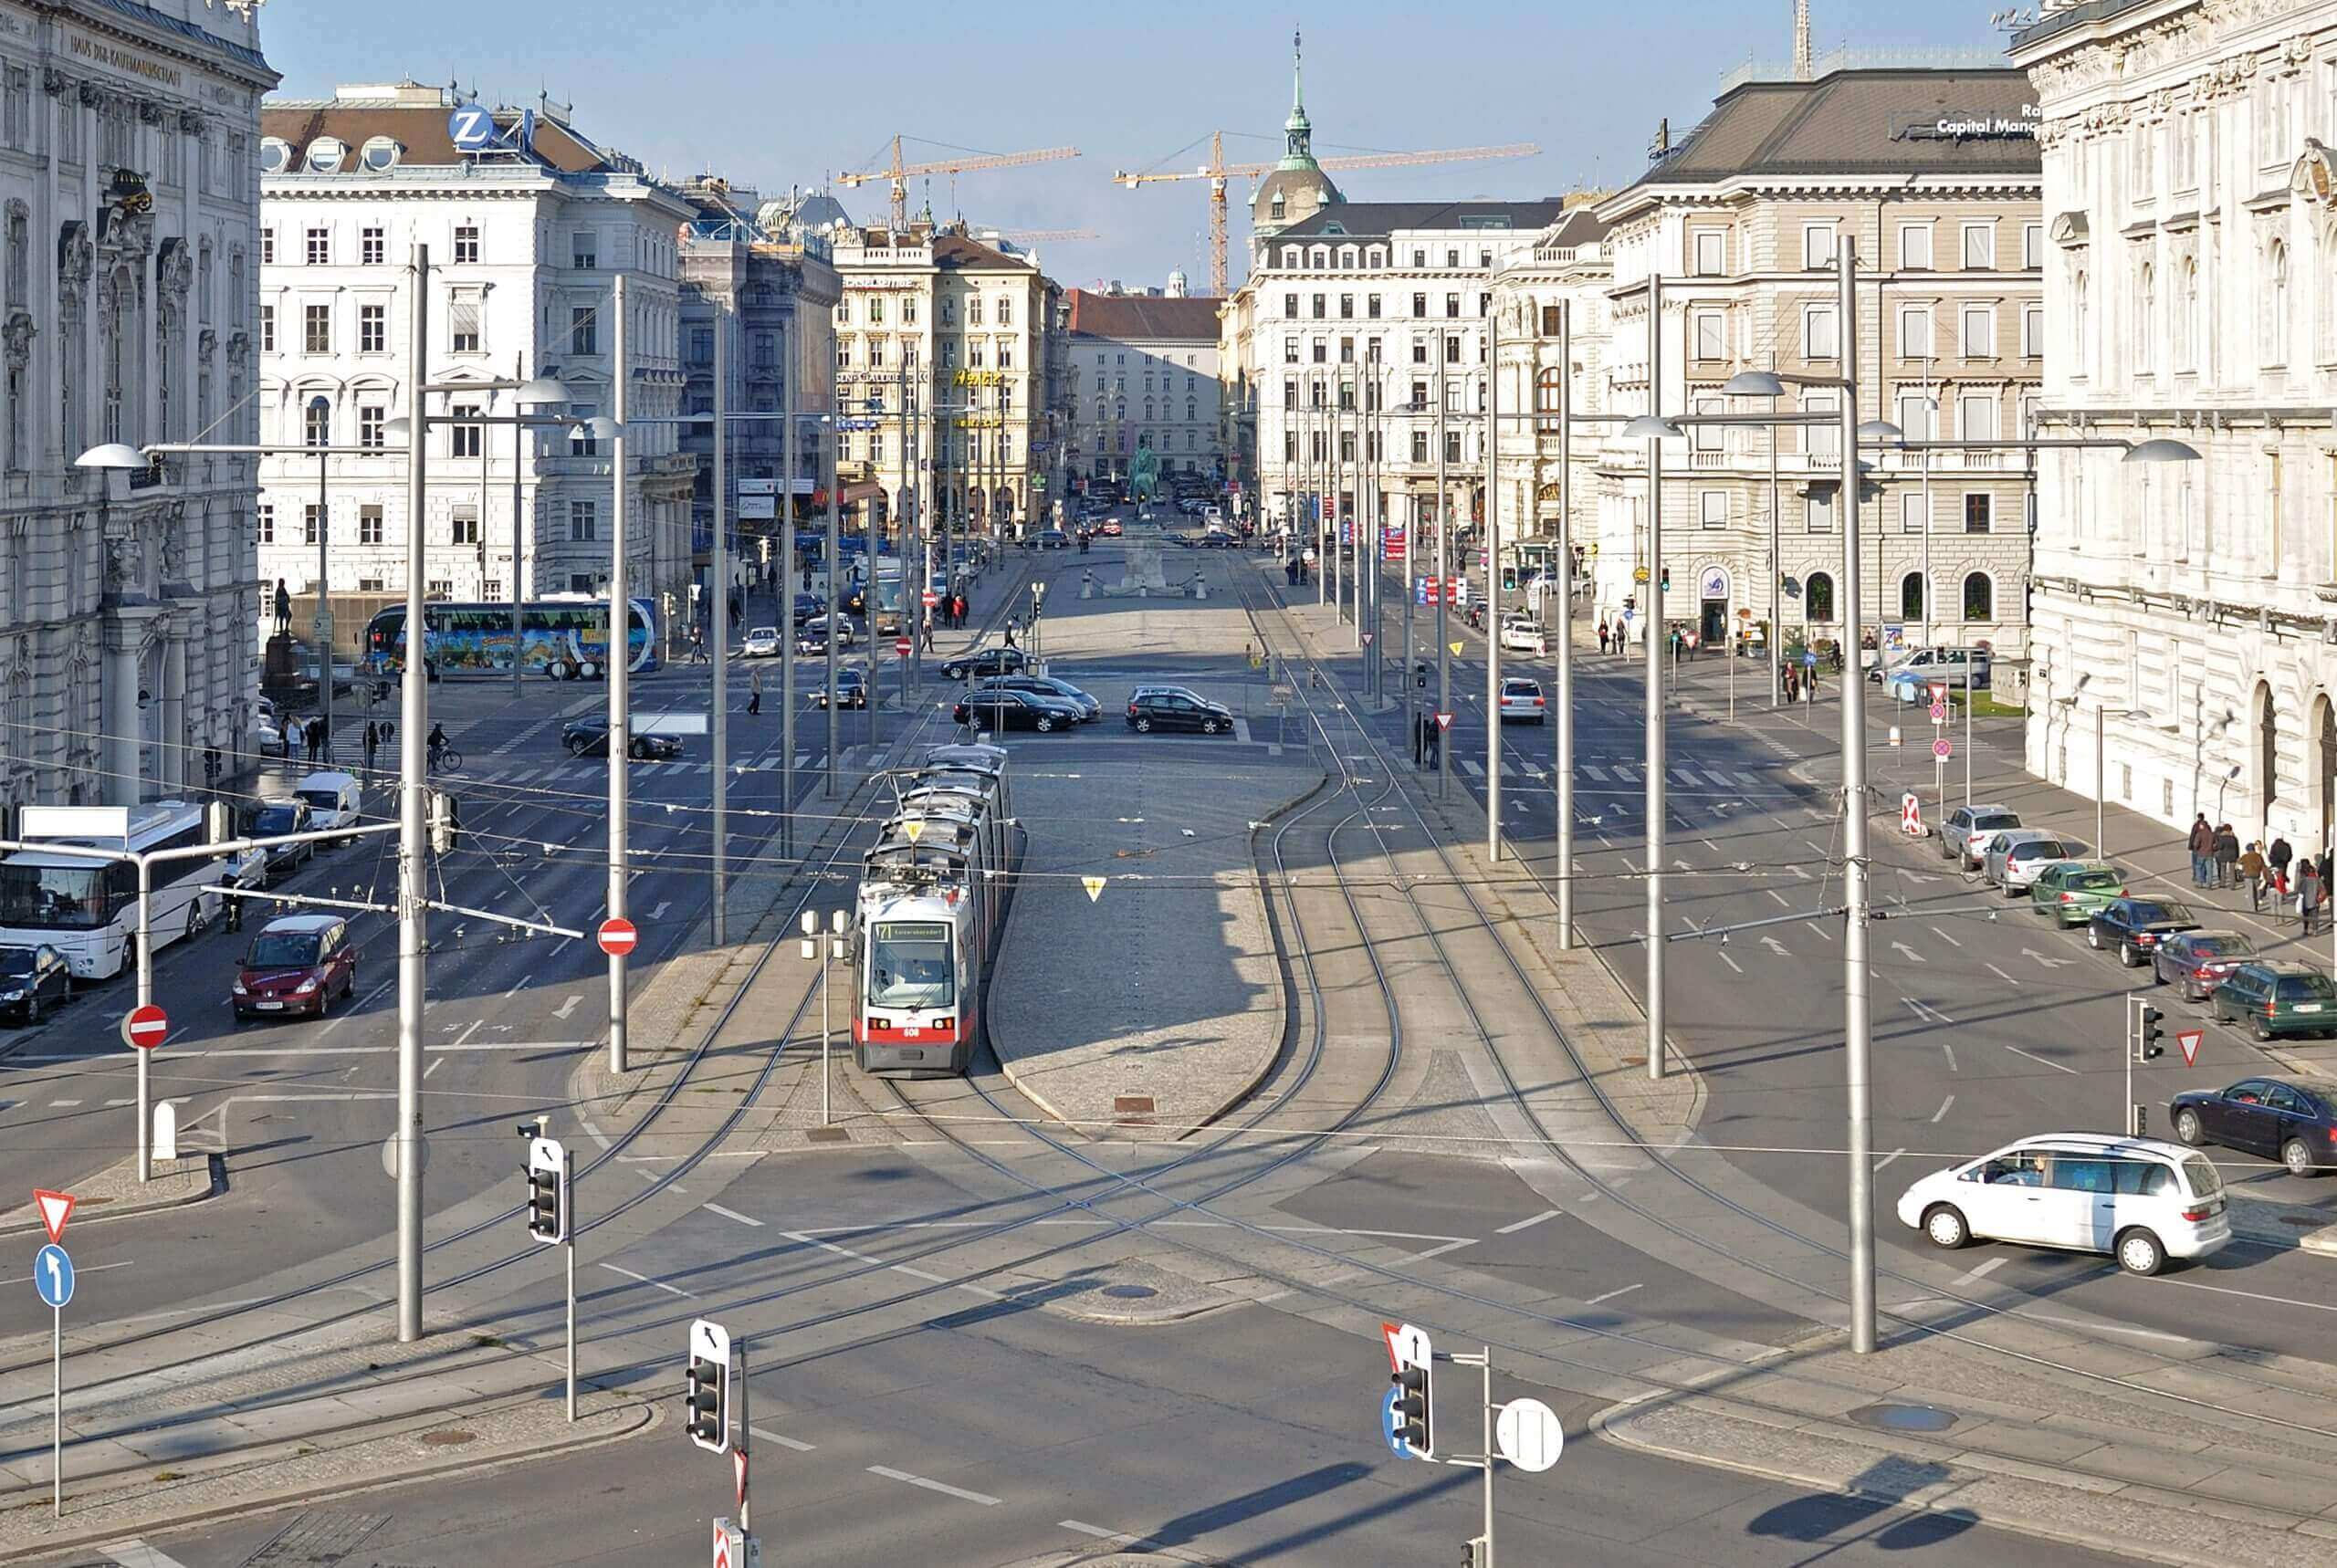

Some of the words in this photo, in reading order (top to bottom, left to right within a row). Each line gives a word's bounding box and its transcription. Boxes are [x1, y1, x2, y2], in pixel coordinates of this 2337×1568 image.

[69, 35, 91, 57] HAUS
[93, 43, 109, 63] DER
[110, 49, 182, 89] KAUFMANNSCHAFT
[454, 110, 487, 143] Z
[1936, 118, 1990, 137] Capital
[953, 369, 1001, 387] Hertz
